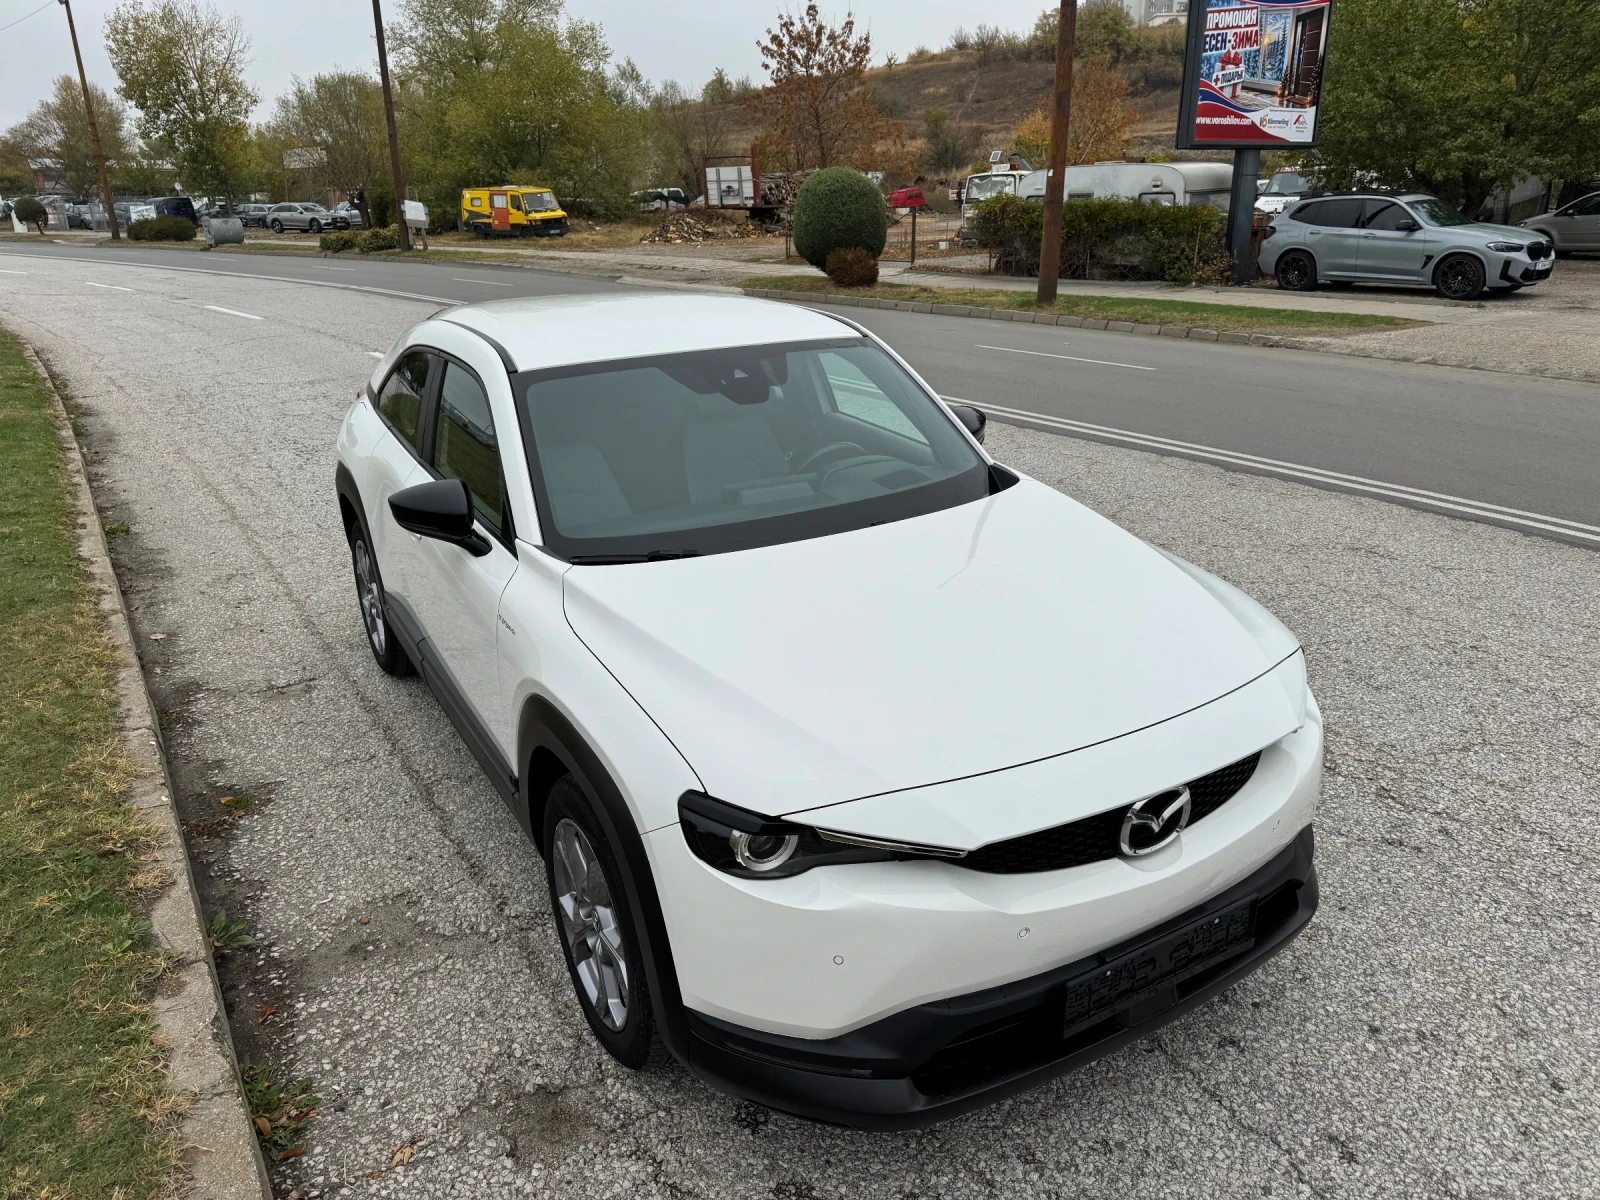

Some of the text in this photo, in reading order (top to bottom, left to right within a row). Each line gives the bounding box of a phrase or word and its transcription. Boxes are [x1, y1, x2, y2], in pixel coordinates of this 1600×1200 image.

[1206, 9, 1258, 29] ПРОМОЦИЯ
[1203, 30, 1258, 52] ЕСЕН-ЗИМА
[1196, 115, 1252, 125] www.voroshilov.com
